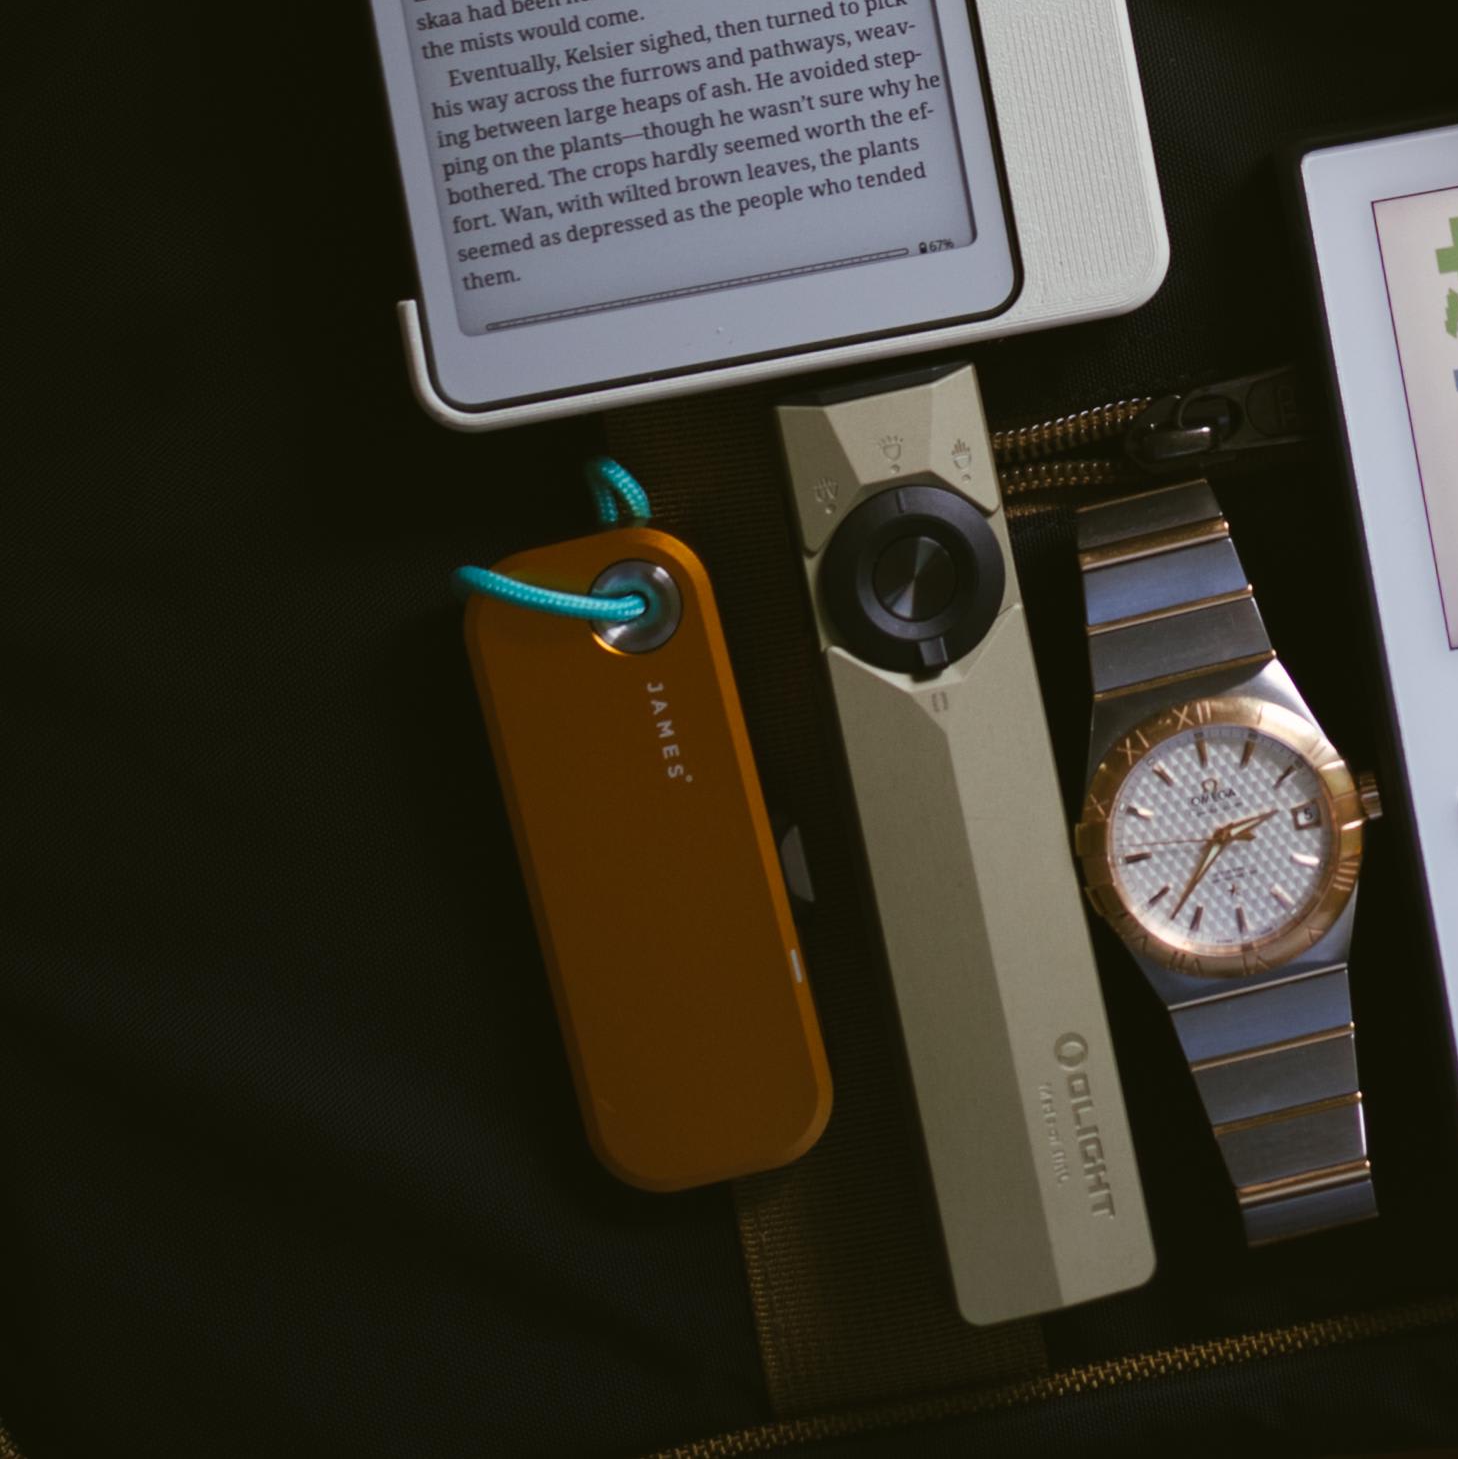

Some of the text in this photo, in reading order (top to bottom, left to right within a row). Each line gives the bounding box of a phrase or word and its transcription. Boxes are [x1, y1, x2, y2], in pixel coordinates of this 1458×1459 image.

[415, 10, 463, 31] skaa
[429, 20, 916, 120] his way across the furrows and pathways, weav-
[440, 72, 941, 183] ping on the plants—though he wasn’t sure why he
[460, 268, 521, 291] them.
[646, 682, 685, 779] JAMES
[1190, 788, 1237, 805] OMEGA
[1068, 1072, 1116, 1219] OLIGHT
